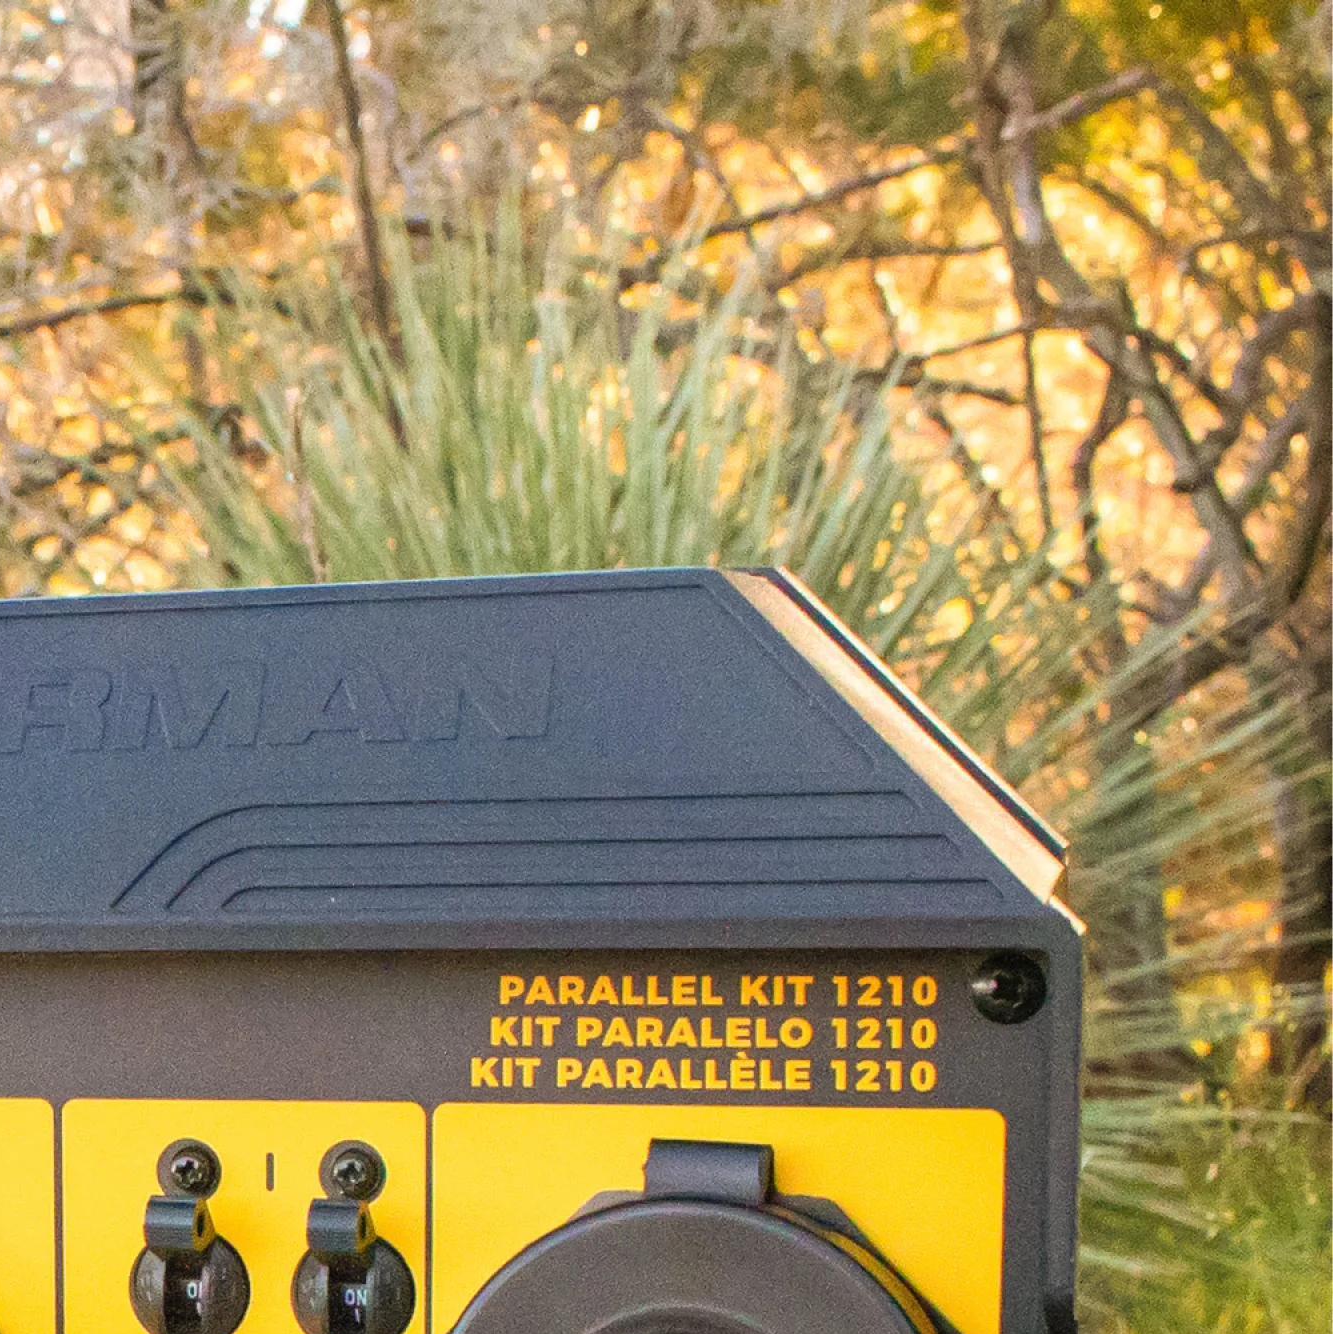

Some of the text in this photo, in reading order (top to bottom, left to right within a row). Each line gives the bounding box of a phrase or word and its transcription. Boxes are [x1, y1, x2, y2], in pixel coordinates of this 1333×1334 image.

[498, 974, 939, 1008] PARALLEL KIT 1210
[489, 1015, 939, 1050] KIT PARALELO 1210
[470, 1050, 938, 1093] KIT PARALLÈLE 1210
[187, 1281, 203, 1299] O
[345, 1288, 367, 1306] ON
